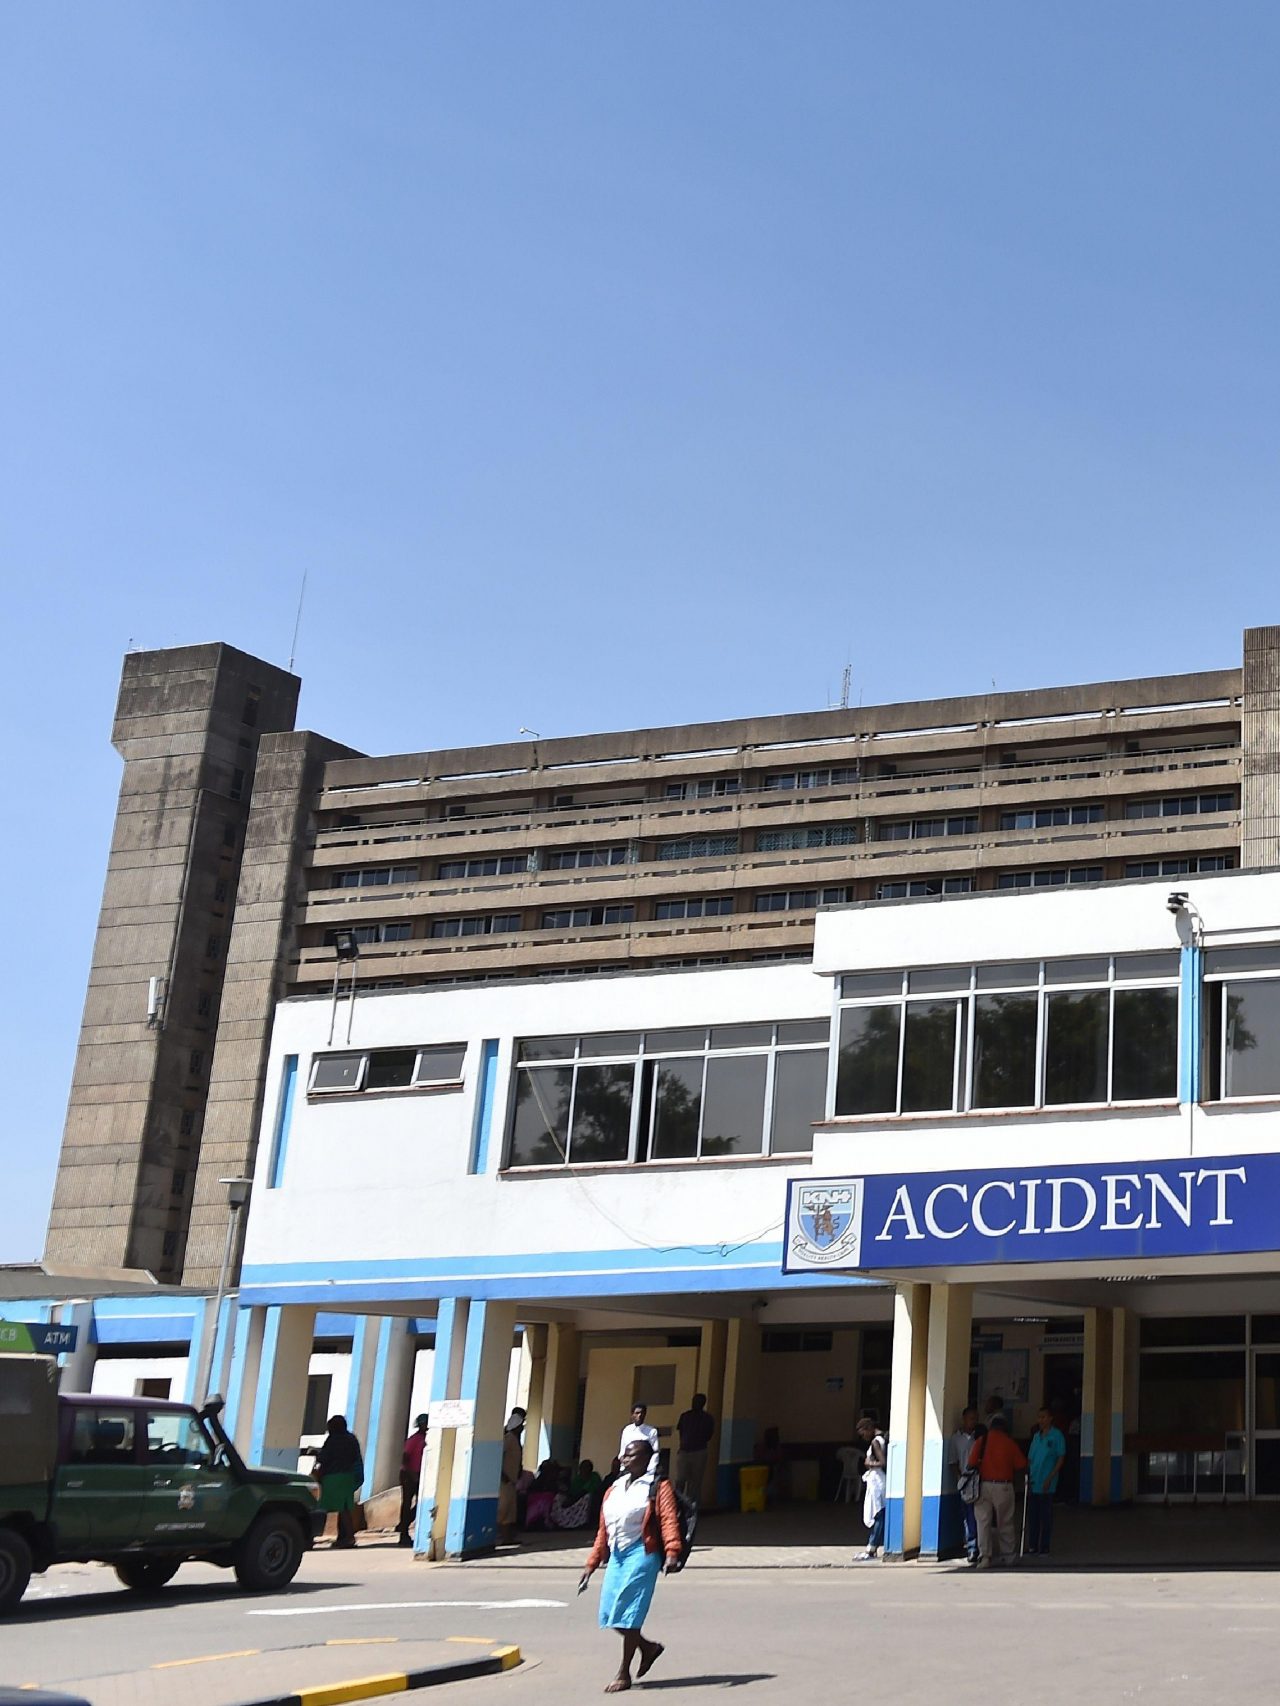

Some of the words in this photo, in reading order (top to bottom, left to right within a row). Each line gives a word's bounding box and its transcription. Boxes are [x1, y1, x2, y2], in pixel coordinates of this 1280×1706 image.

[874, 1167, 1246, 1241] ACCIDENT
[0, 1327, 17, 1342] CB
[43, 1331, 70, 1345] ATM
